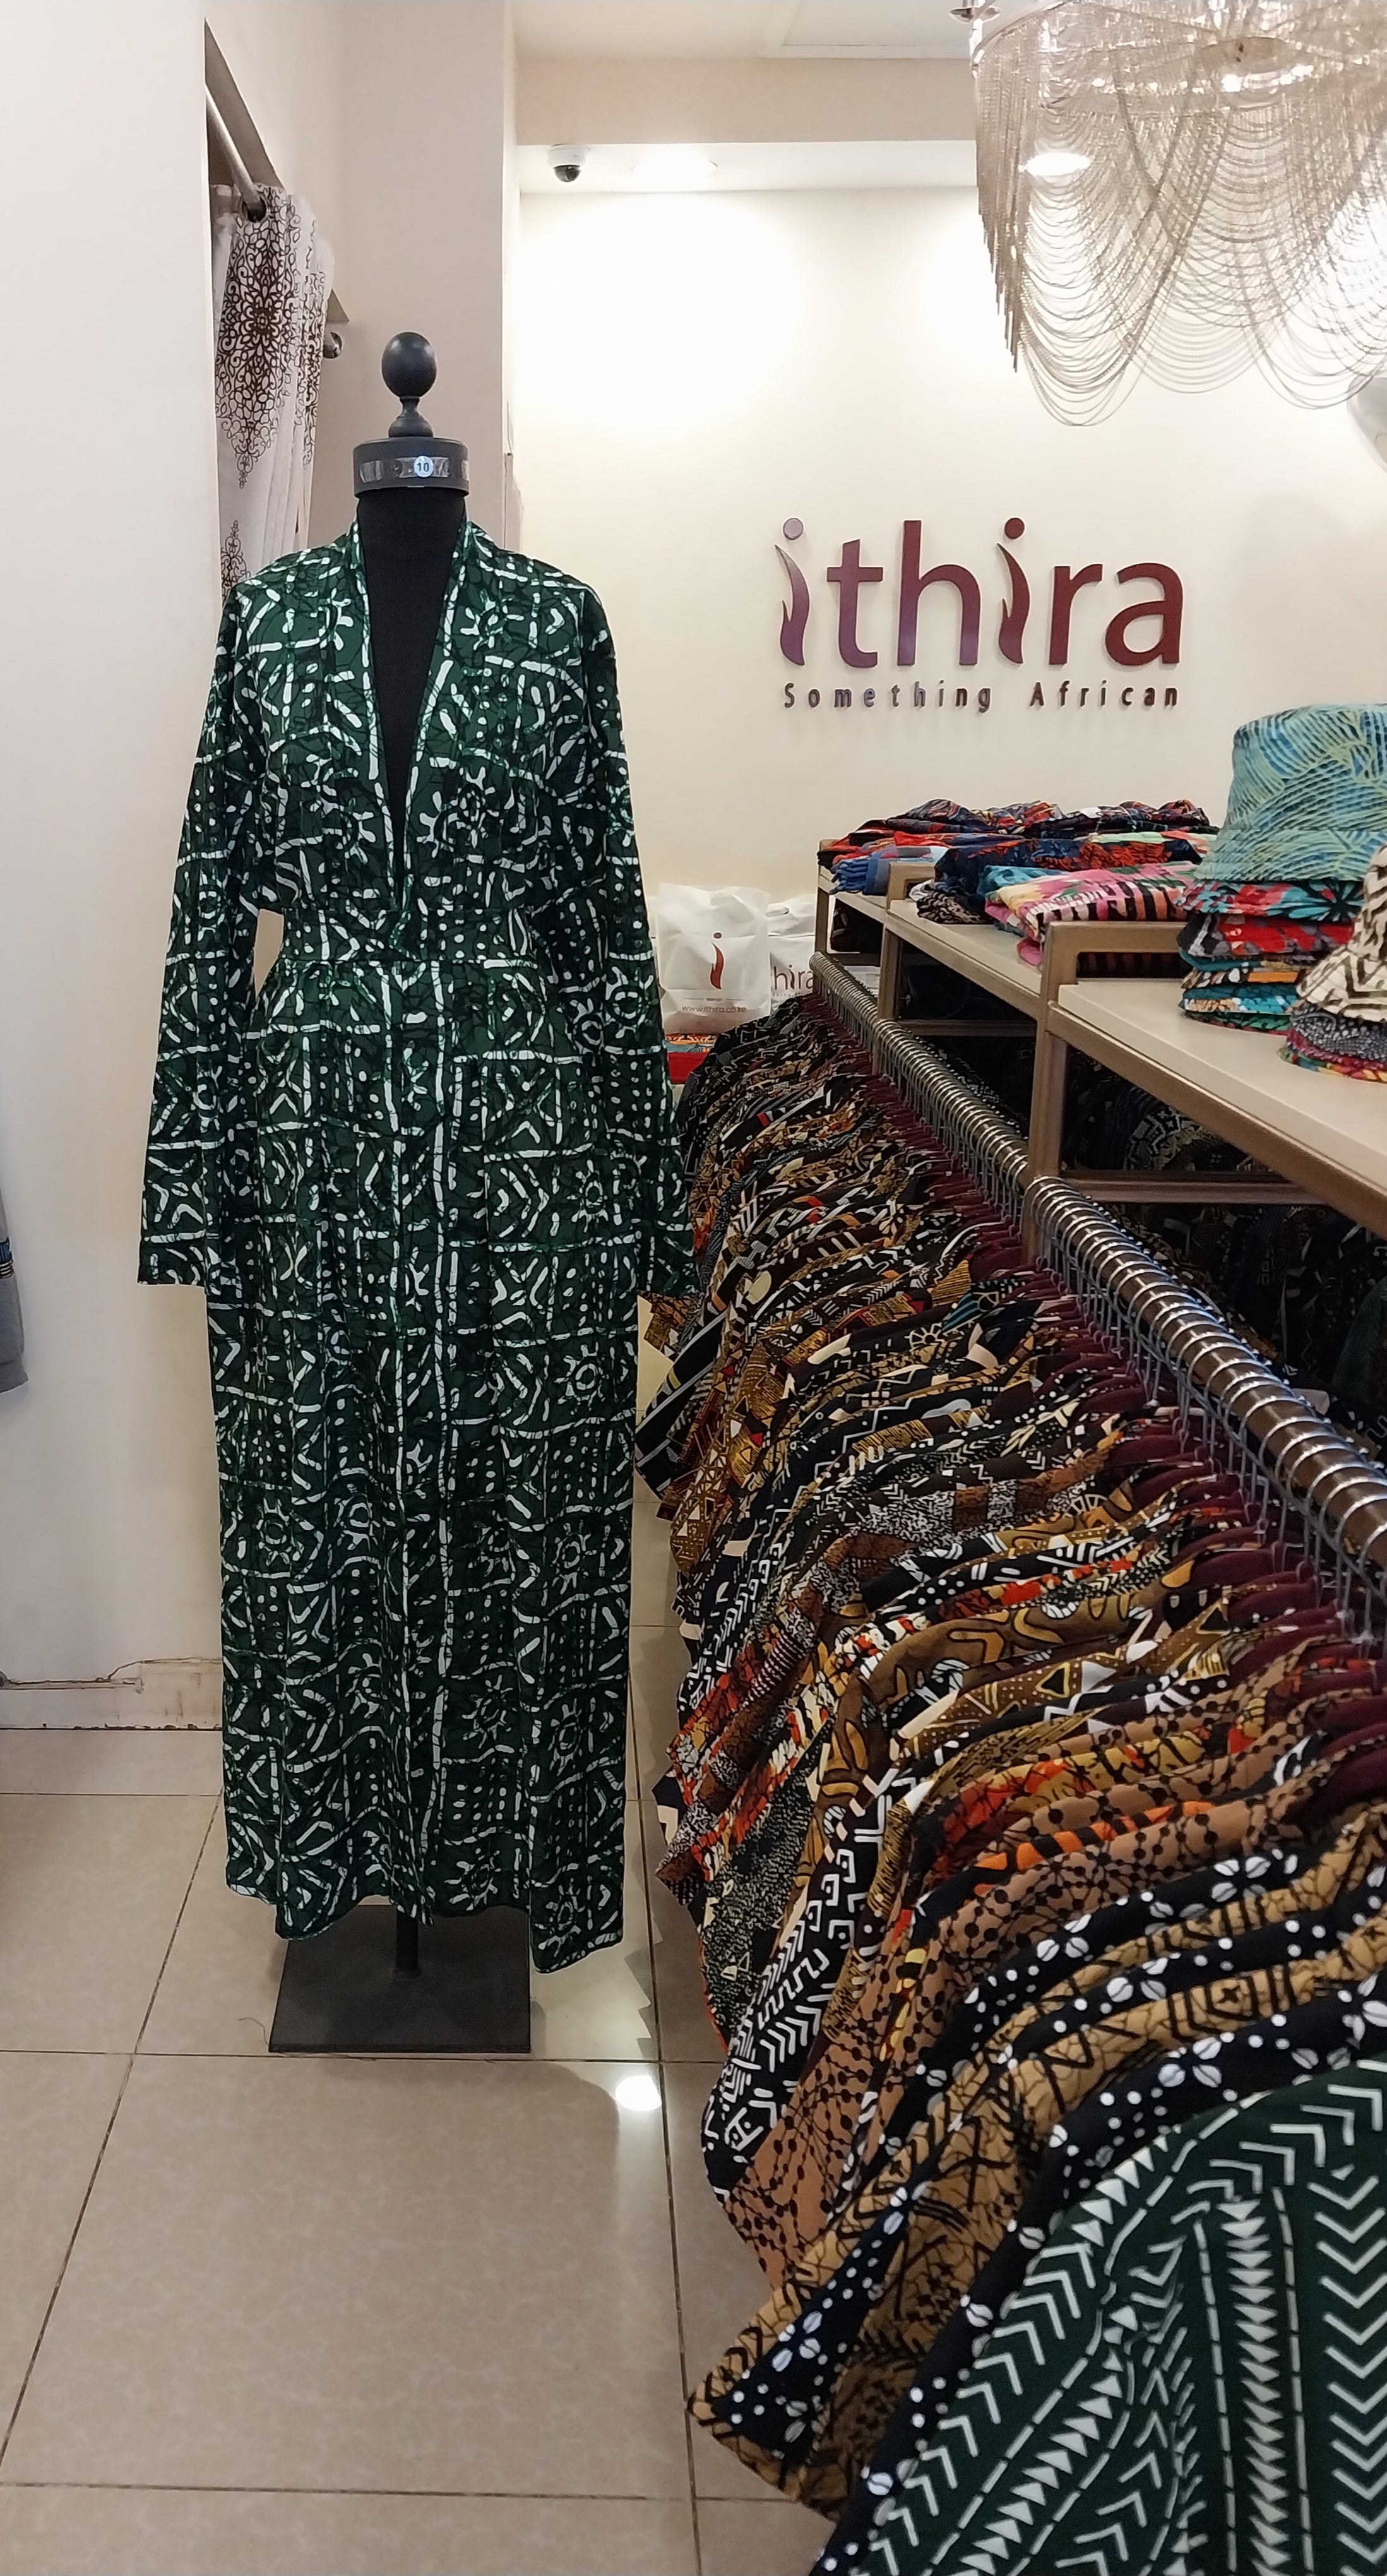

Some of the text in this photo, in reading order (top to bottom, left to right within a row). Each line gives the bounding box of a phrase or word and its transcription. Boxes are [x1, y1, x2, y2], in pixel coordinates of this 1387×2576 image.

[417, 462, 429, 472] 10
[775, 516, 1183, 668] ithira
[783, 679, 1177, 712] Something African
[773, 964, 813, 990] hira
